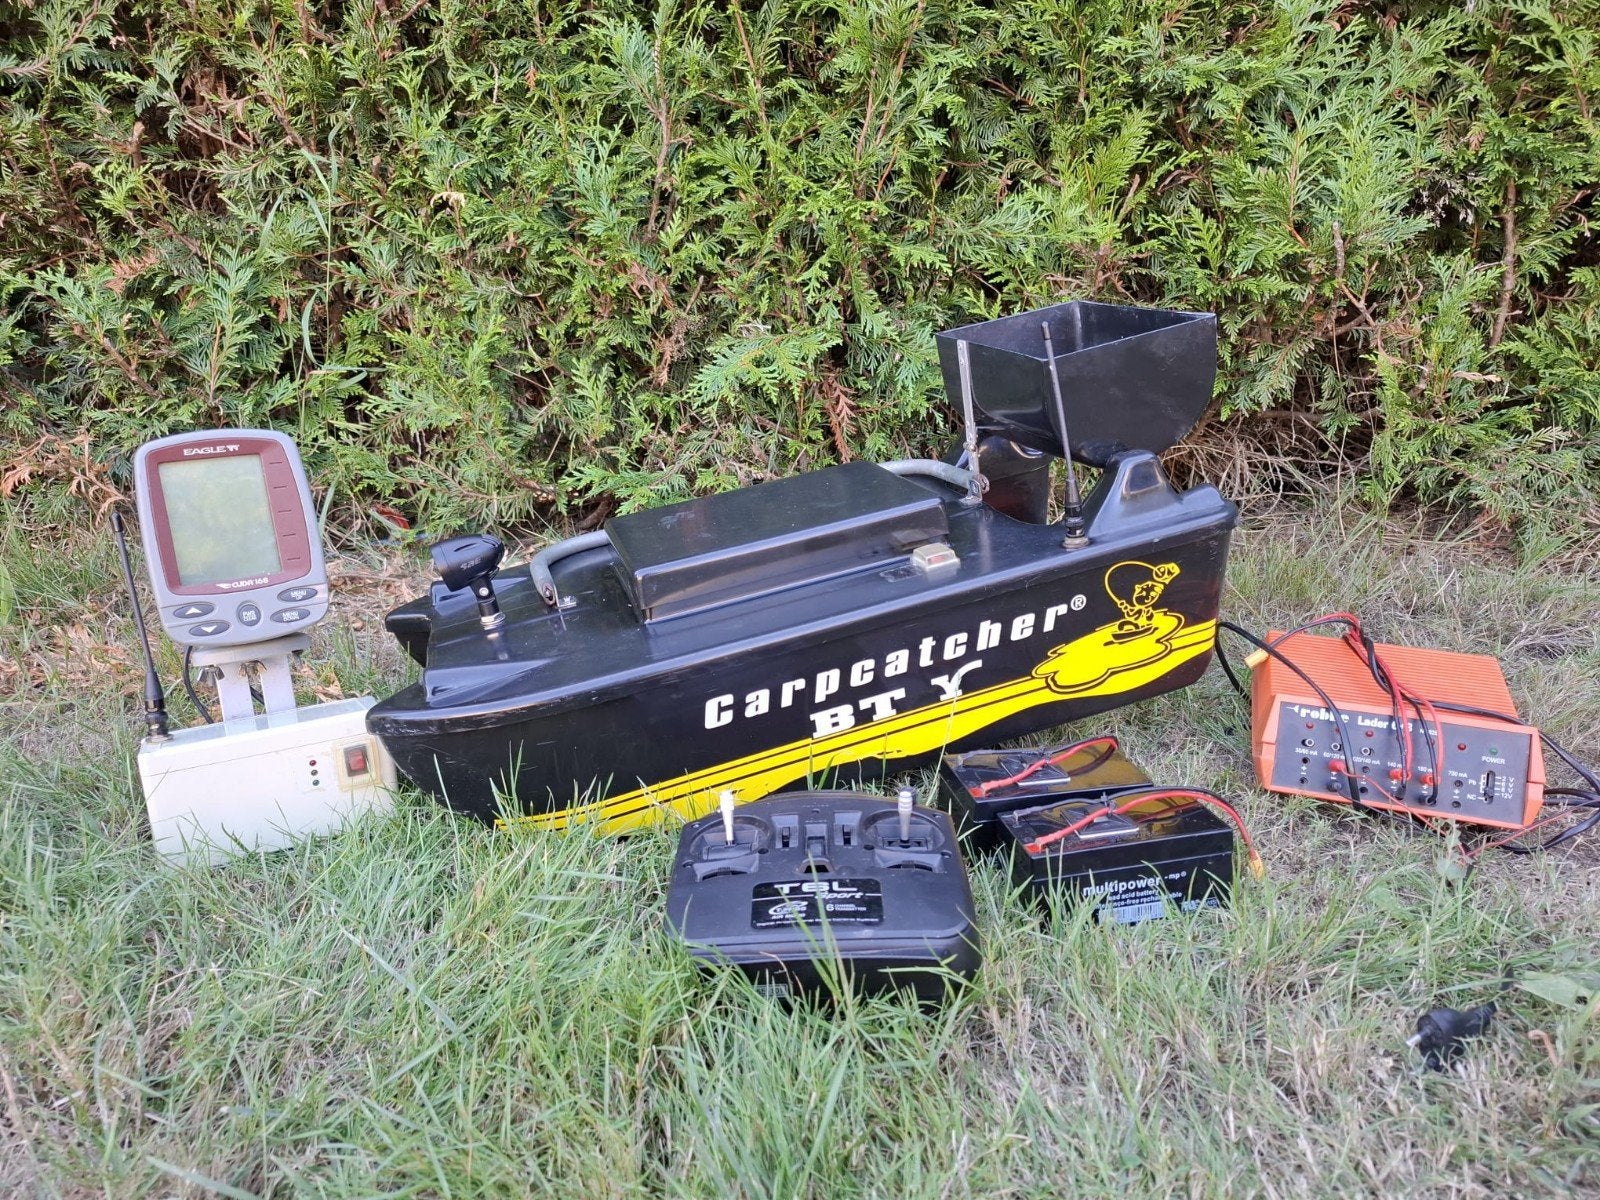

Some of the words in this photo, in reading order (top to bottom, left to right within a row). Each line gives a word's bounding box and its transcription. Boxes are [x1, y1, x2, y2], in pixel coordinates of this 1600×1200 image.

[183, 445, 227, 456] EAGLE
[1299, 708, 1350, 723] robe
[1357, 715, 1389, 729] Lader
[1481, 755, 1506, 765] POWER
[1121, 890, 1136, 899] acid
[825, 903, 835, 912] 6
